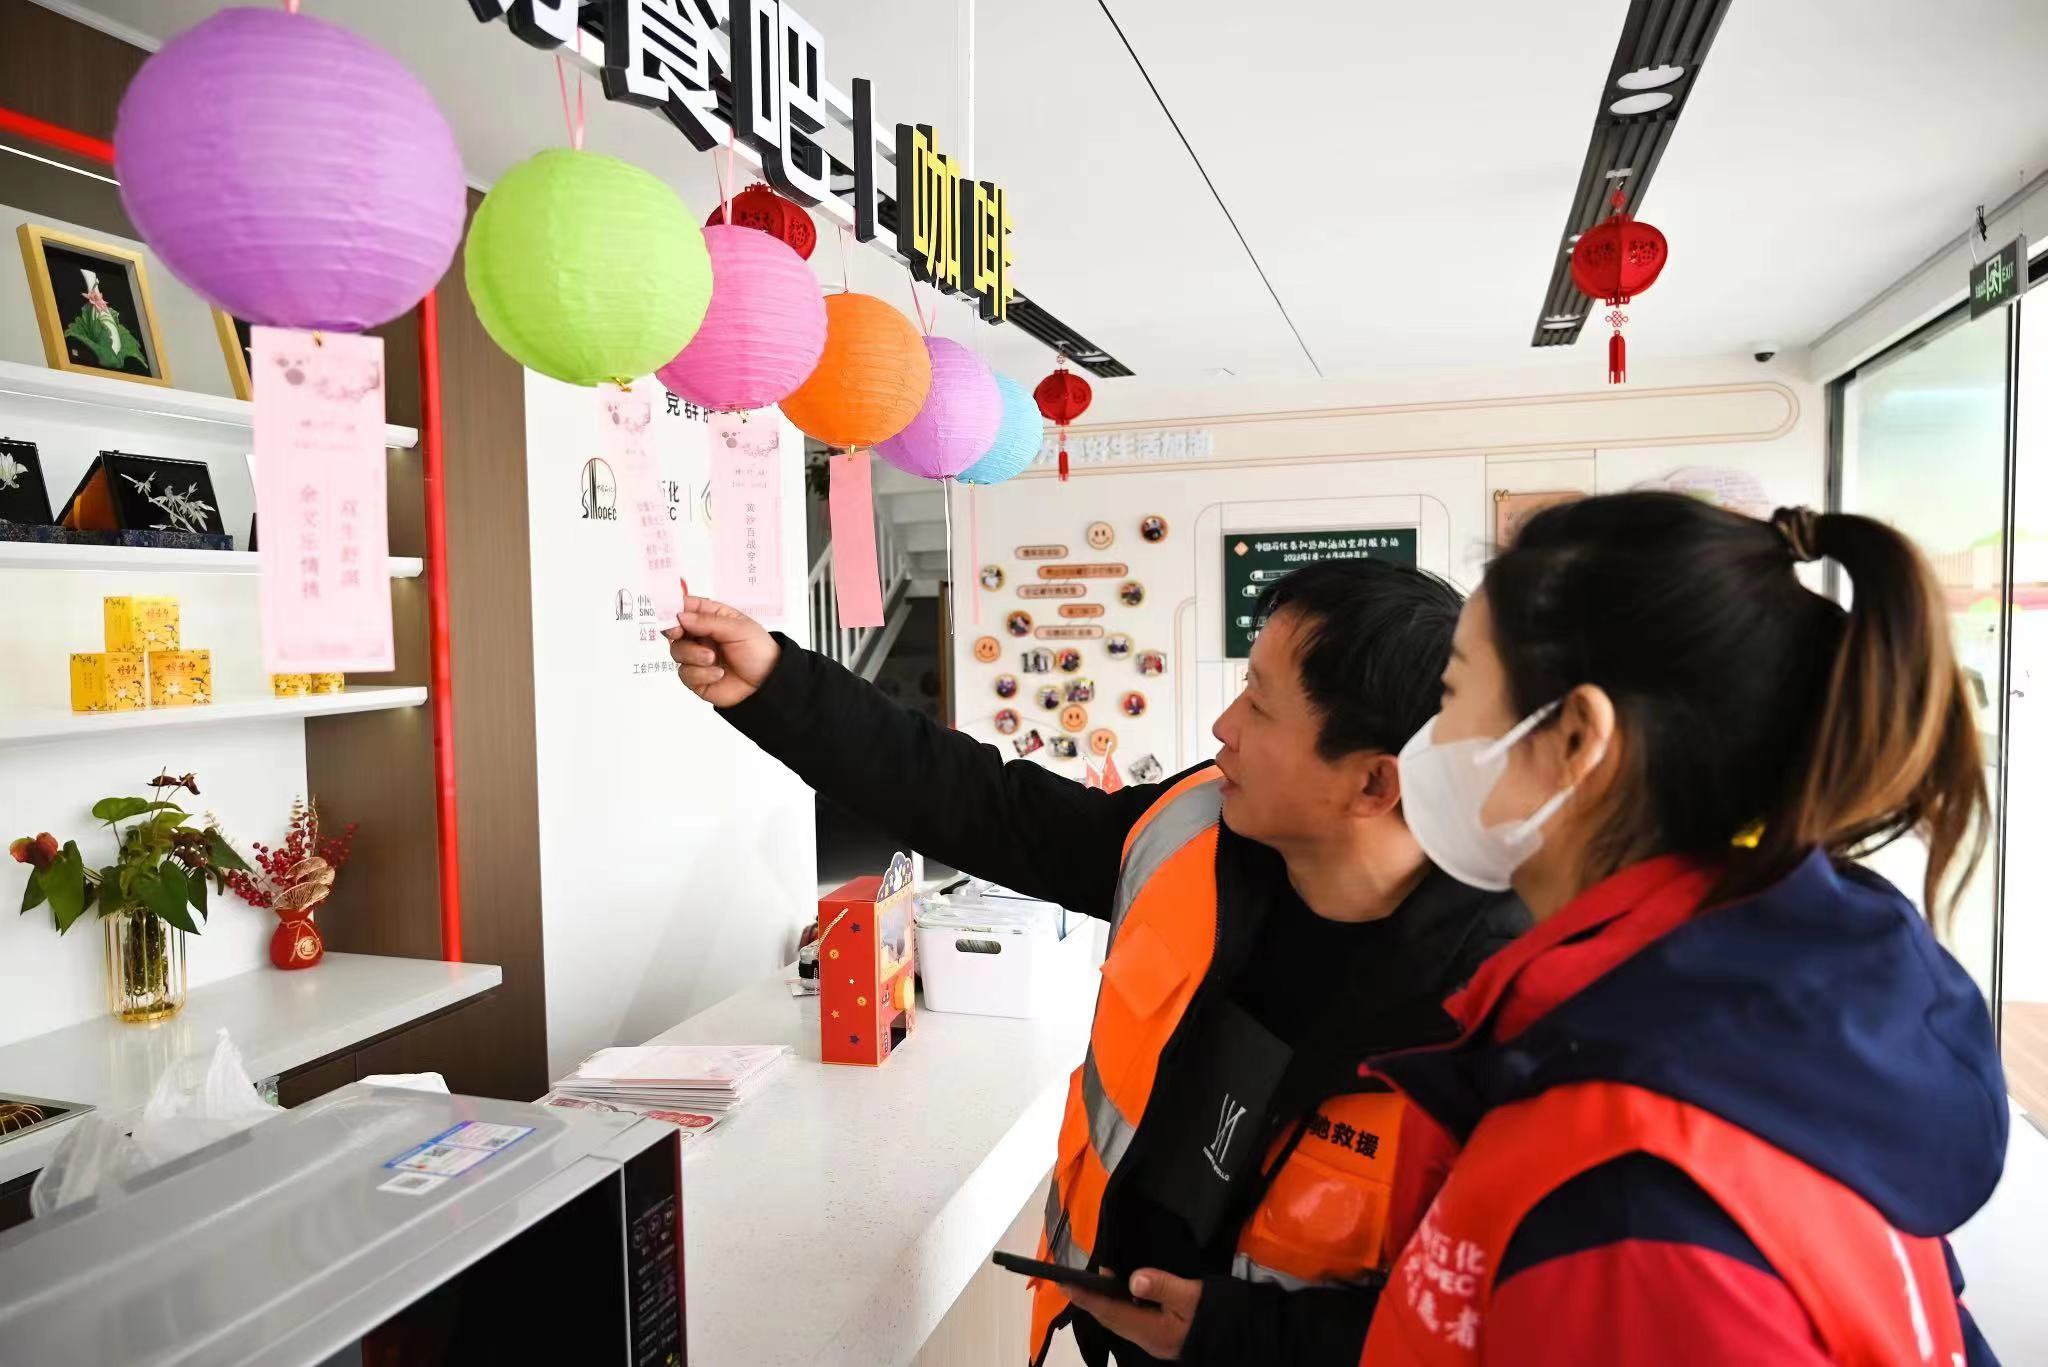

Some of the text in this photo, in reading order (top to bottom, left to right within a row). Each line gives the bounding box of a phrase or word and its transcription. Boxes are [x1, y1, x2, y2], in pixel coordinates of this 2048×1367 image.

[2001, 261, 2015, 283] EXIT
[744, 502, 758, 586] 黄沙百战穿金甲
